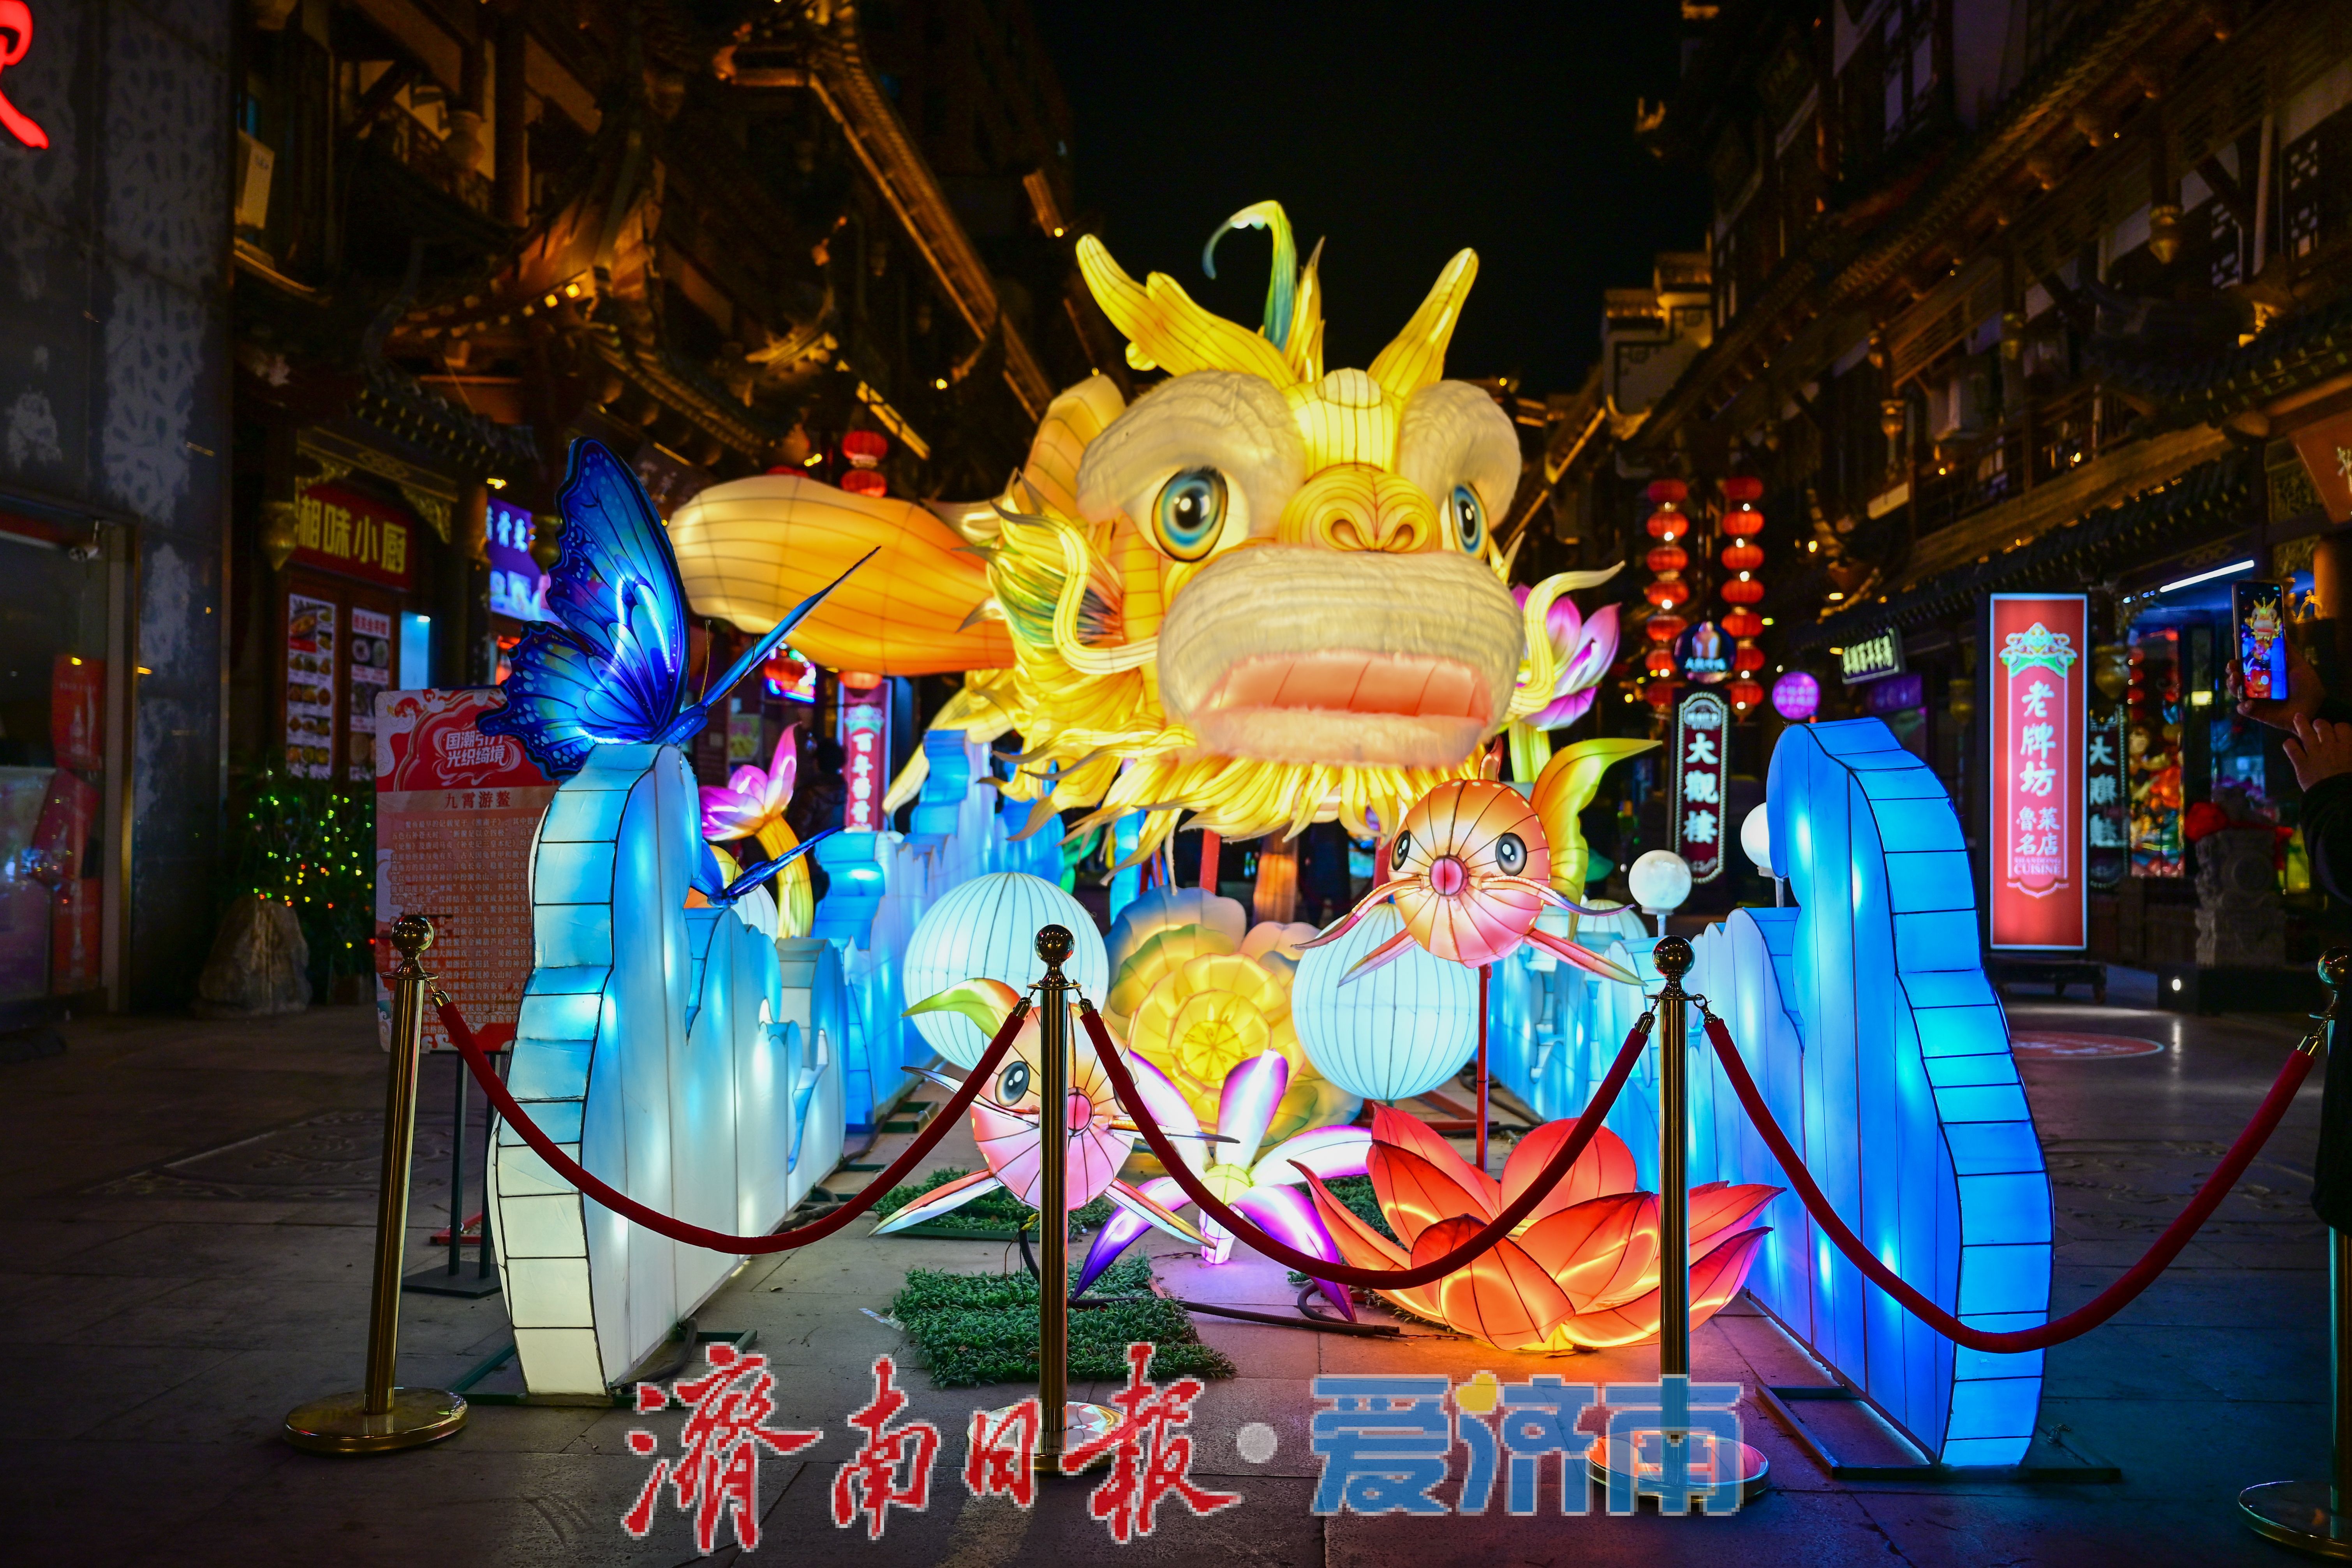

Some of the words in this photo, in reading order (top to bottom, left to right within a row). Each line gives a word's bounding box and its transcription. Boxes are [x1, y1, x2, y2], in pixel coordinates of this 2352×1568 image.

[2020, 680, 2056, 797] 老牌坊
[446, 745, 507, 768] 光织绮境
[445, 790, 511, 810] 九霄游鳌
[2014, 832, 2058, 856] 名店
[2014, 864, 2061, 875] CUISINE
